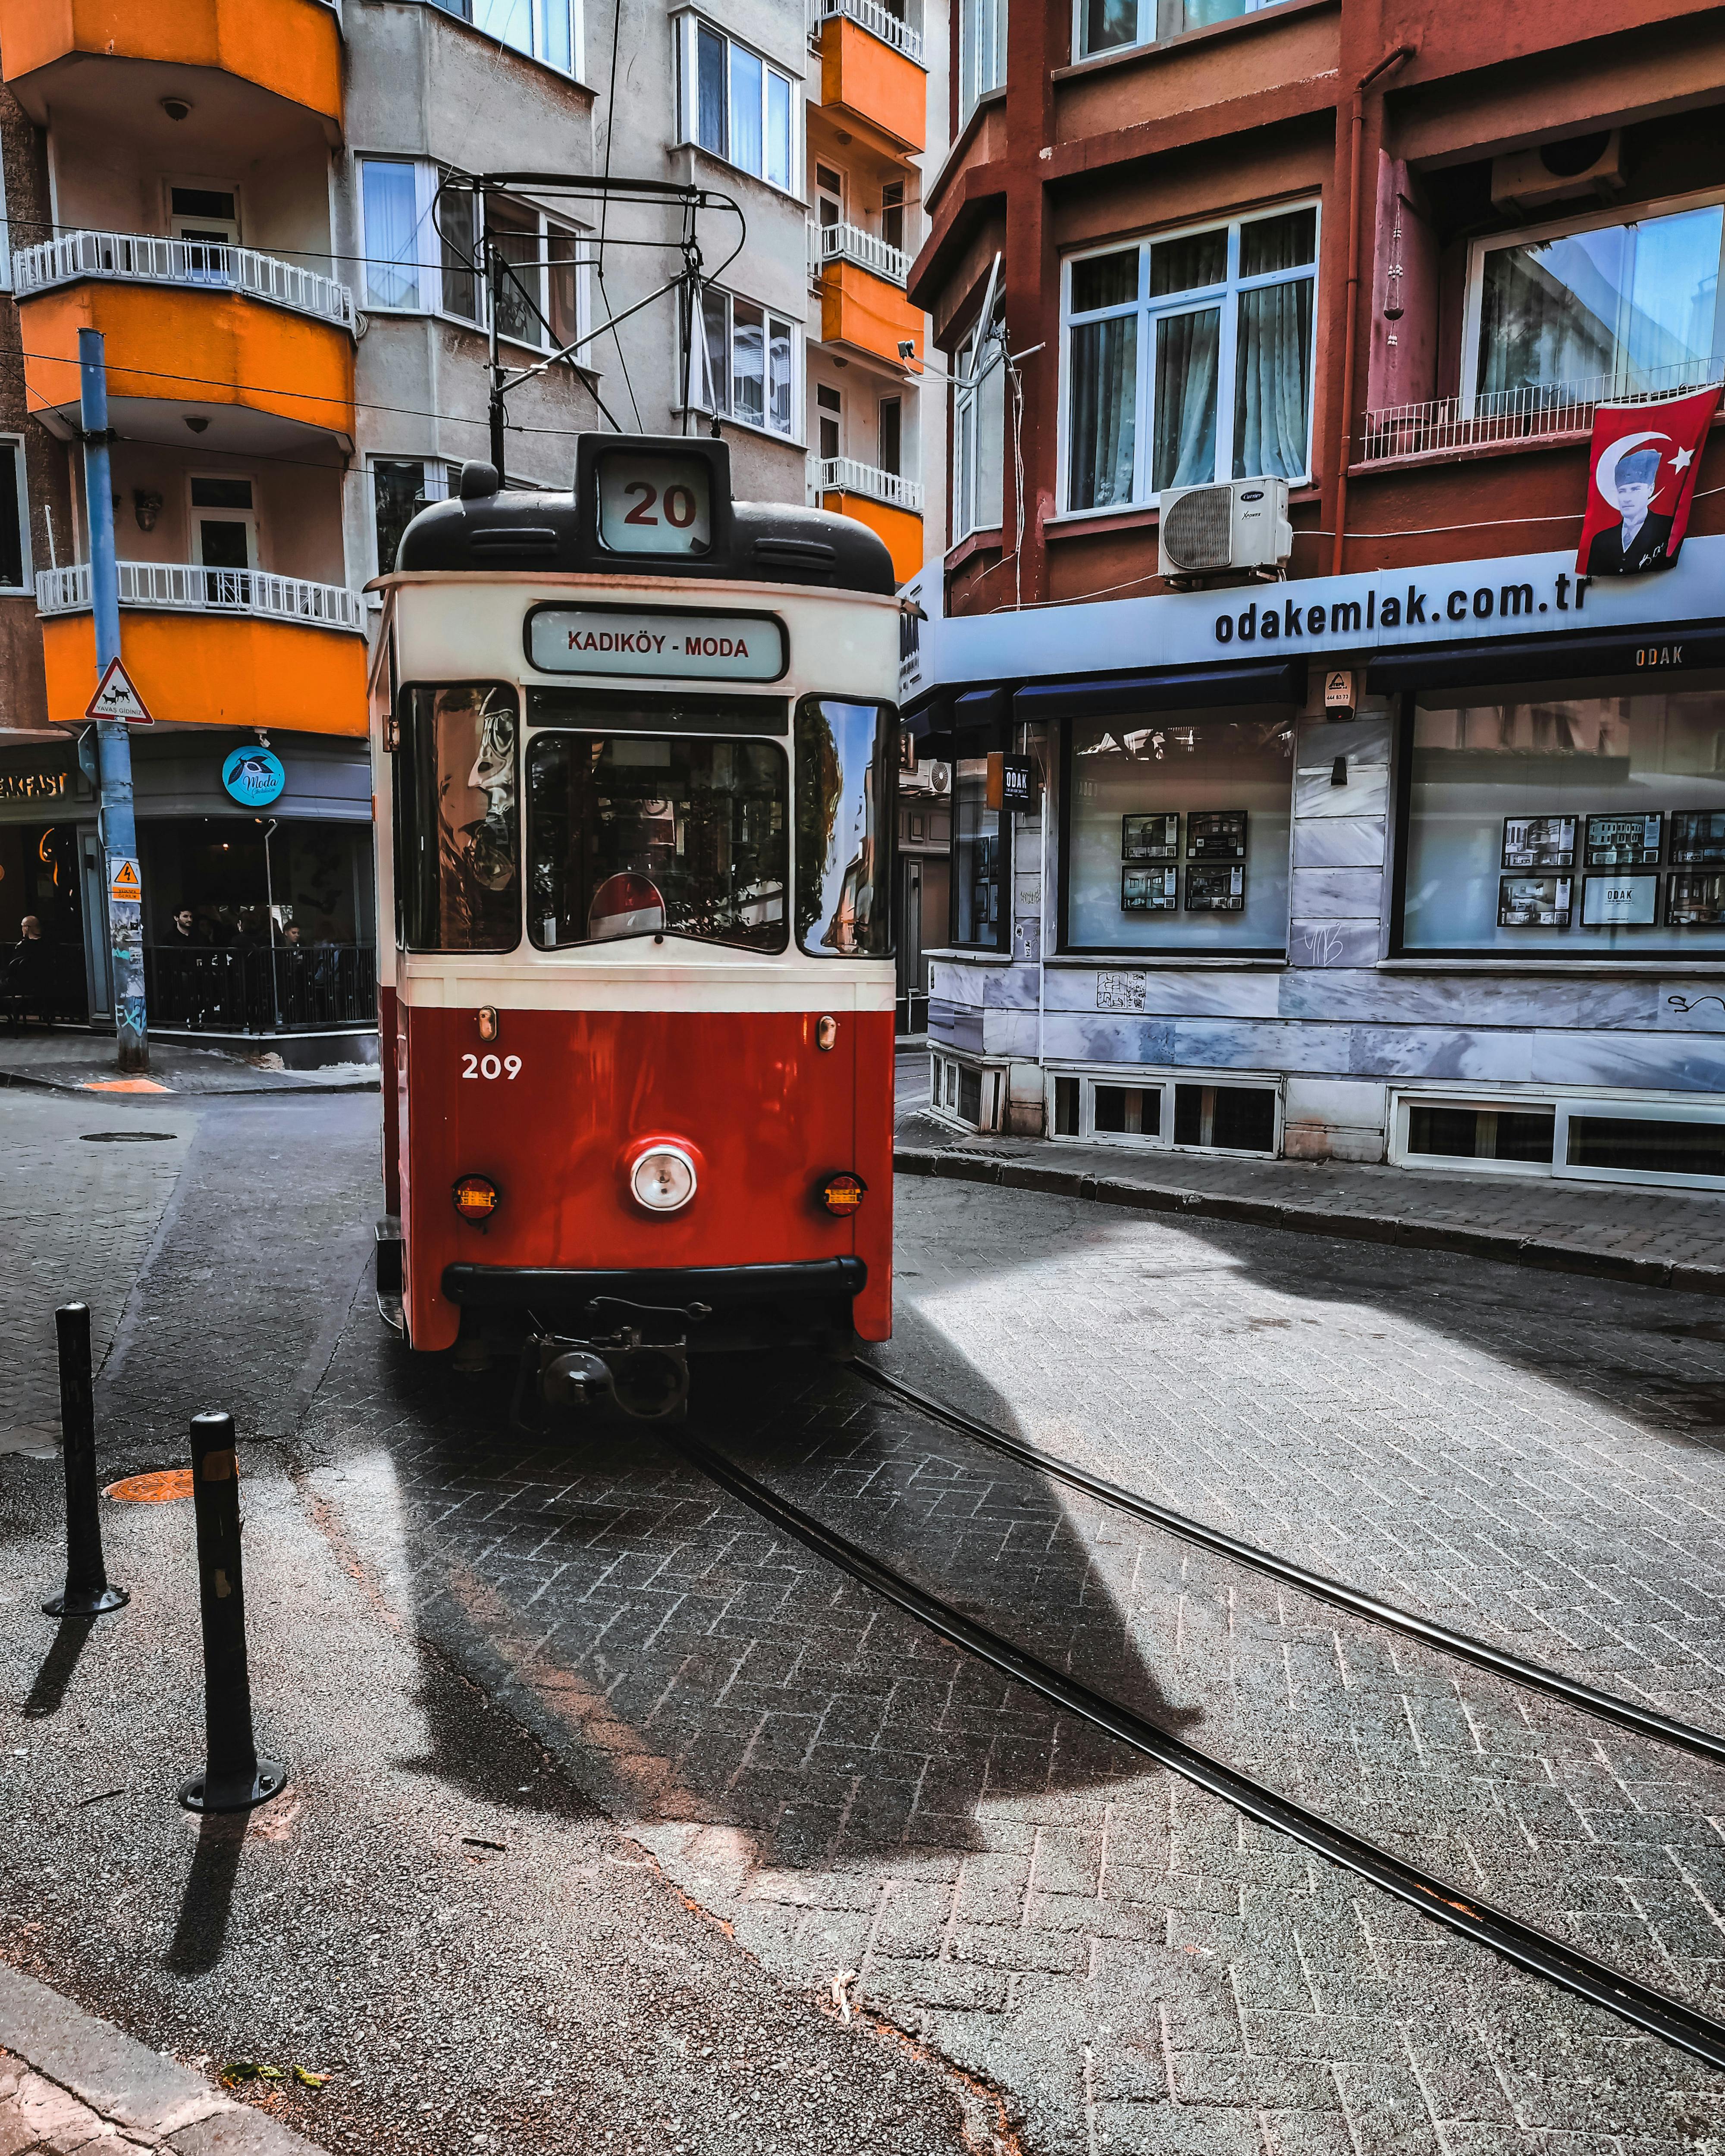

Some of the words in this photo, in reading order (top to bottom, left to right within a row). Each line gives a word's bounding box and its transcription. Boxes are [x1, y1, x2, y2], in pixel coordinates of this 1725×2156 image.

[624, 482, 696, 528] 20
[1215, 573, 1592, 643] odakemlak.com.tr
[568, 630, 666, 654] KADIKÖY
[686, 636, 749, 658] MODA
[1636, 646, 1682, 666] ODAK
[242, 775, 279, 791] Moda
[1007, 772, 1026, 789] ODAK
[1608, 890, 1632, 899] ODAK
